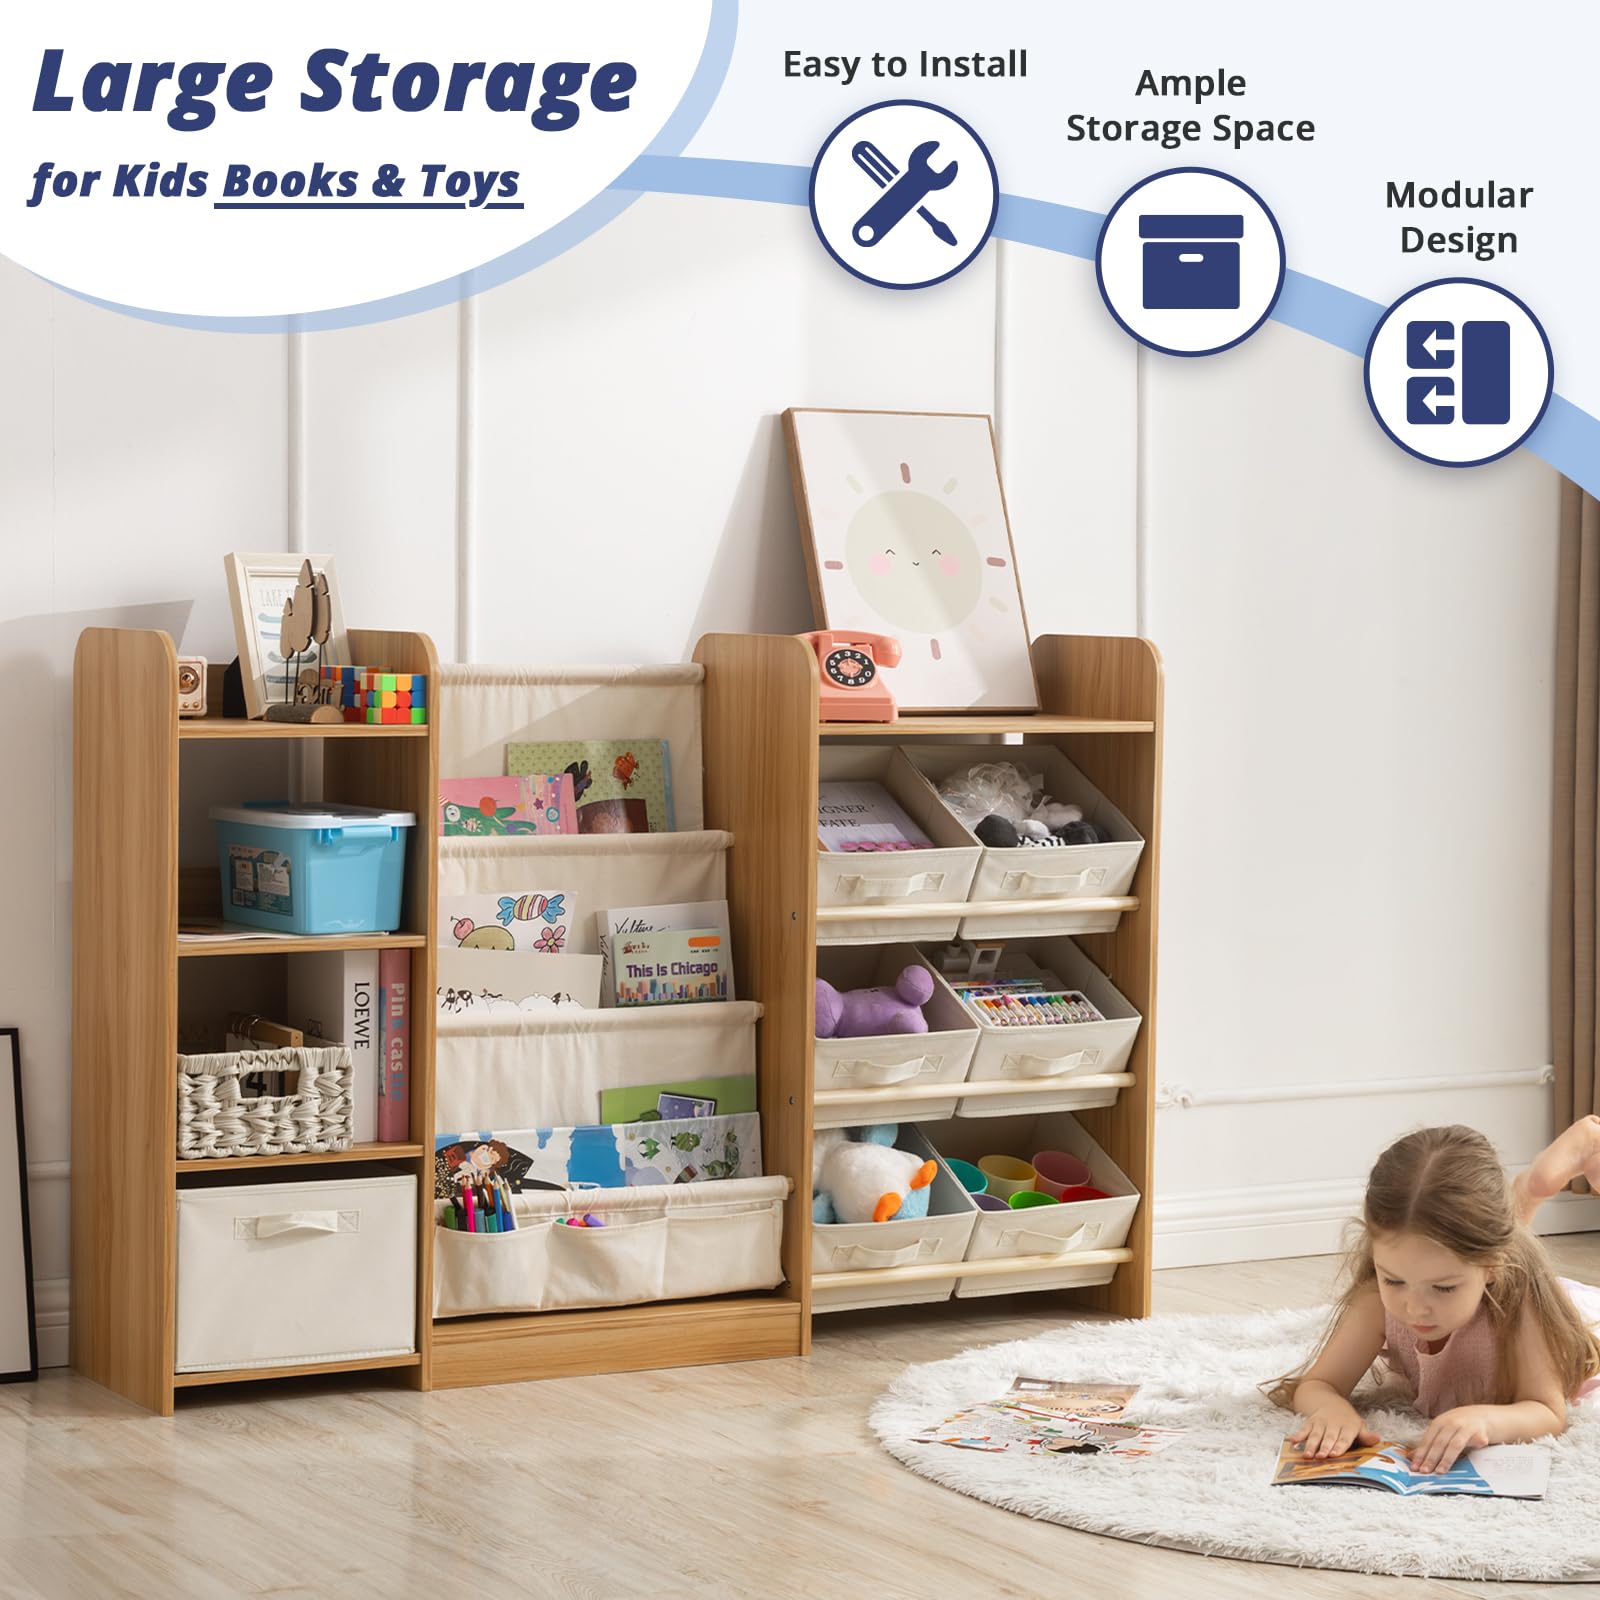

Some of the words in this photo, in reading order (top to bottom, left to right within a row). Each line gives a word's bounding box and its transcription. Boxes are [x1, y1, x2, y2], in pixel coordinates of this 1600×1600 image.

[818, 804, 869, 815] IGNER
[626, 964, 654, 978] This
[656, 963, 668, 976] Is
[670, 961, 718, 977] Chicago
[354, 982, 370, 1050] LOEWE
